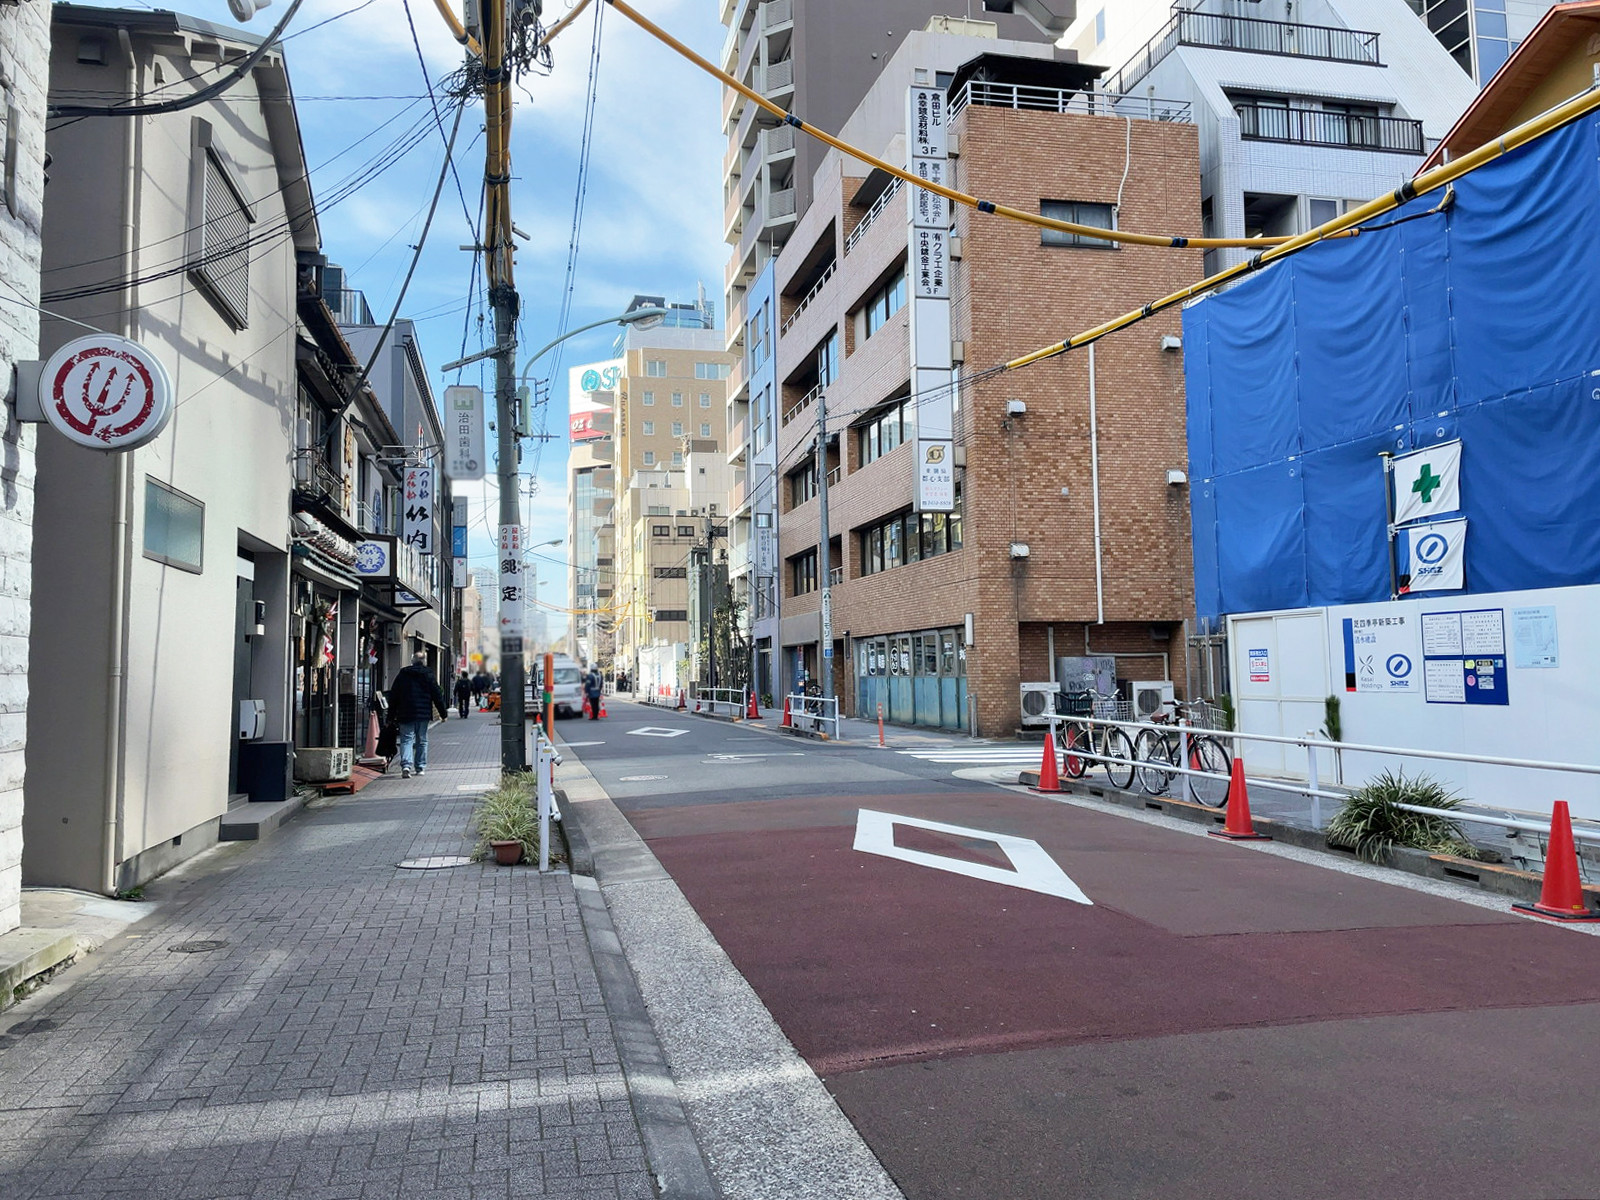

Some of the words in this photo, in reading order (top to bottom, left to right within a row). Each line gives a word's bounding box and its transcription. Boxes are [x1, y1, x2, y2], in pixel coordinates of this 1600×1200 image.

[458, 412, 470, 459] 治田歯科
[406, 504, 429, 549] 竹内
